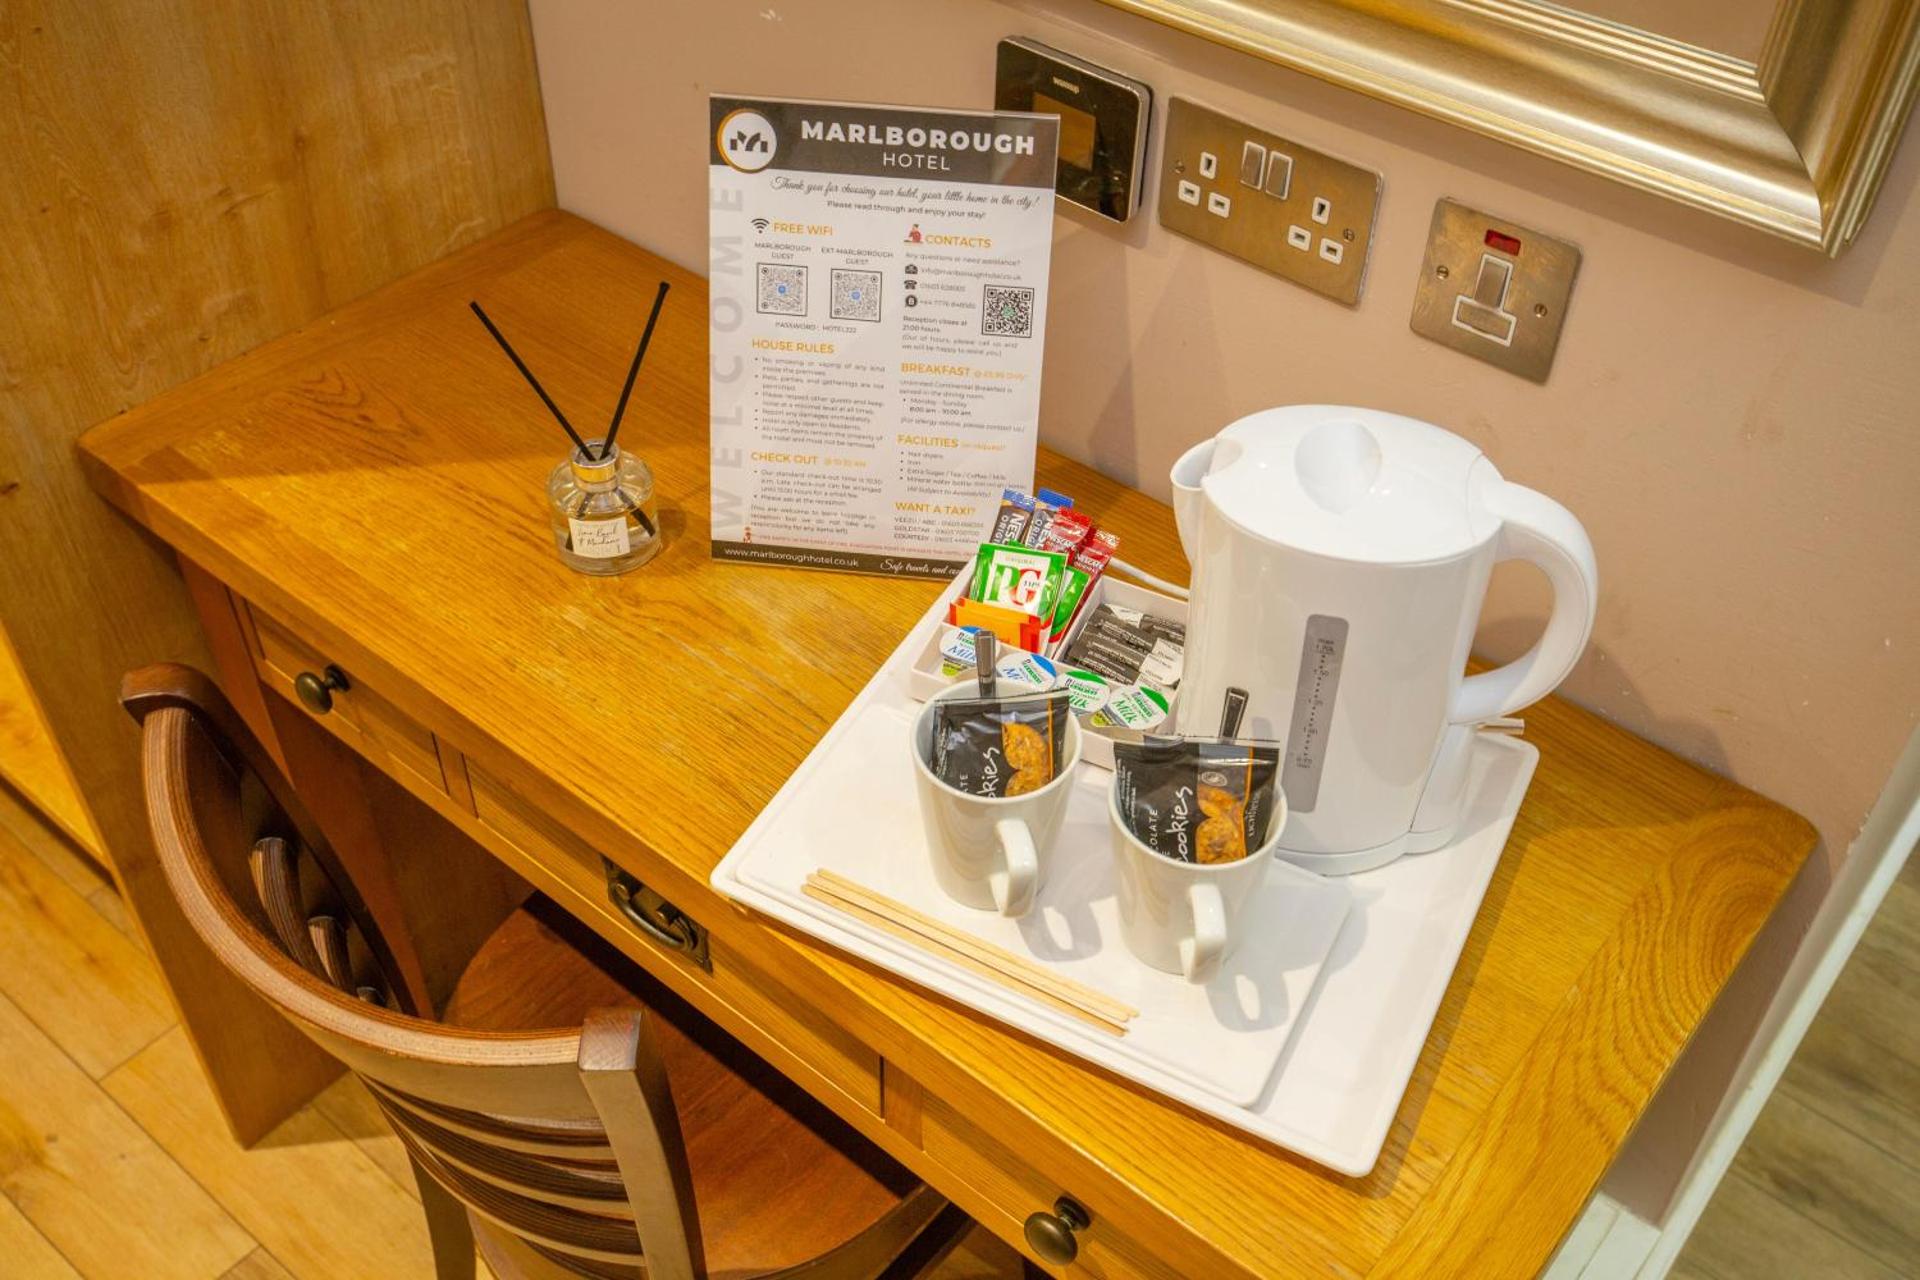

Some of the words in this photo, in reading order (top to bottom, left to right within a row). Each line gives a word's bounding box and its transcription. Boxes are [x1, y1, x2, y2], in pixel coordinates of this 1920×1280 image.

[802, 120, 1034, 155] MARLBOROUGH
[882, 151, 950, 171] HOTEL
[770, 175, 803, 191] Thank
[804, 182, 822, 195] you
[823, 181, 838, 197] for
[841, 183, 875, 198] choosing
[919, 190, 941, 204] your
[1000, 193, 1014, 204] the
[826, 200, 851, 208] Please
[873, 203, 905, 213] through
[907, 205, 922, 213] and
[924, 207, 945, 216] enjoy
[947, 209, 964, 217] your
[773, 222, 803, 234] FREE
[807, 224, 833, 236] WIFI
[926, 234, 991, 248] CONTACTS
[751, 337, 793, 351] HOUSE
[795, 341, 834, 354] RULES
[710, 187, 744, 529] WELCOME
[900, 362, 970, 377] BREAKFAST
[897, 433, 958, 448] FACILITIES
[750, 450, 790, 463] CHECK
[793, 454, 817, 465] OUT
[895, 501, 929, 512] WANT
[724, 548, 860, 568] www.marlboroughhotel.co.uk
[880, 559, 903, 574] Safe
[1068, 694, 1090, 709] ilk
